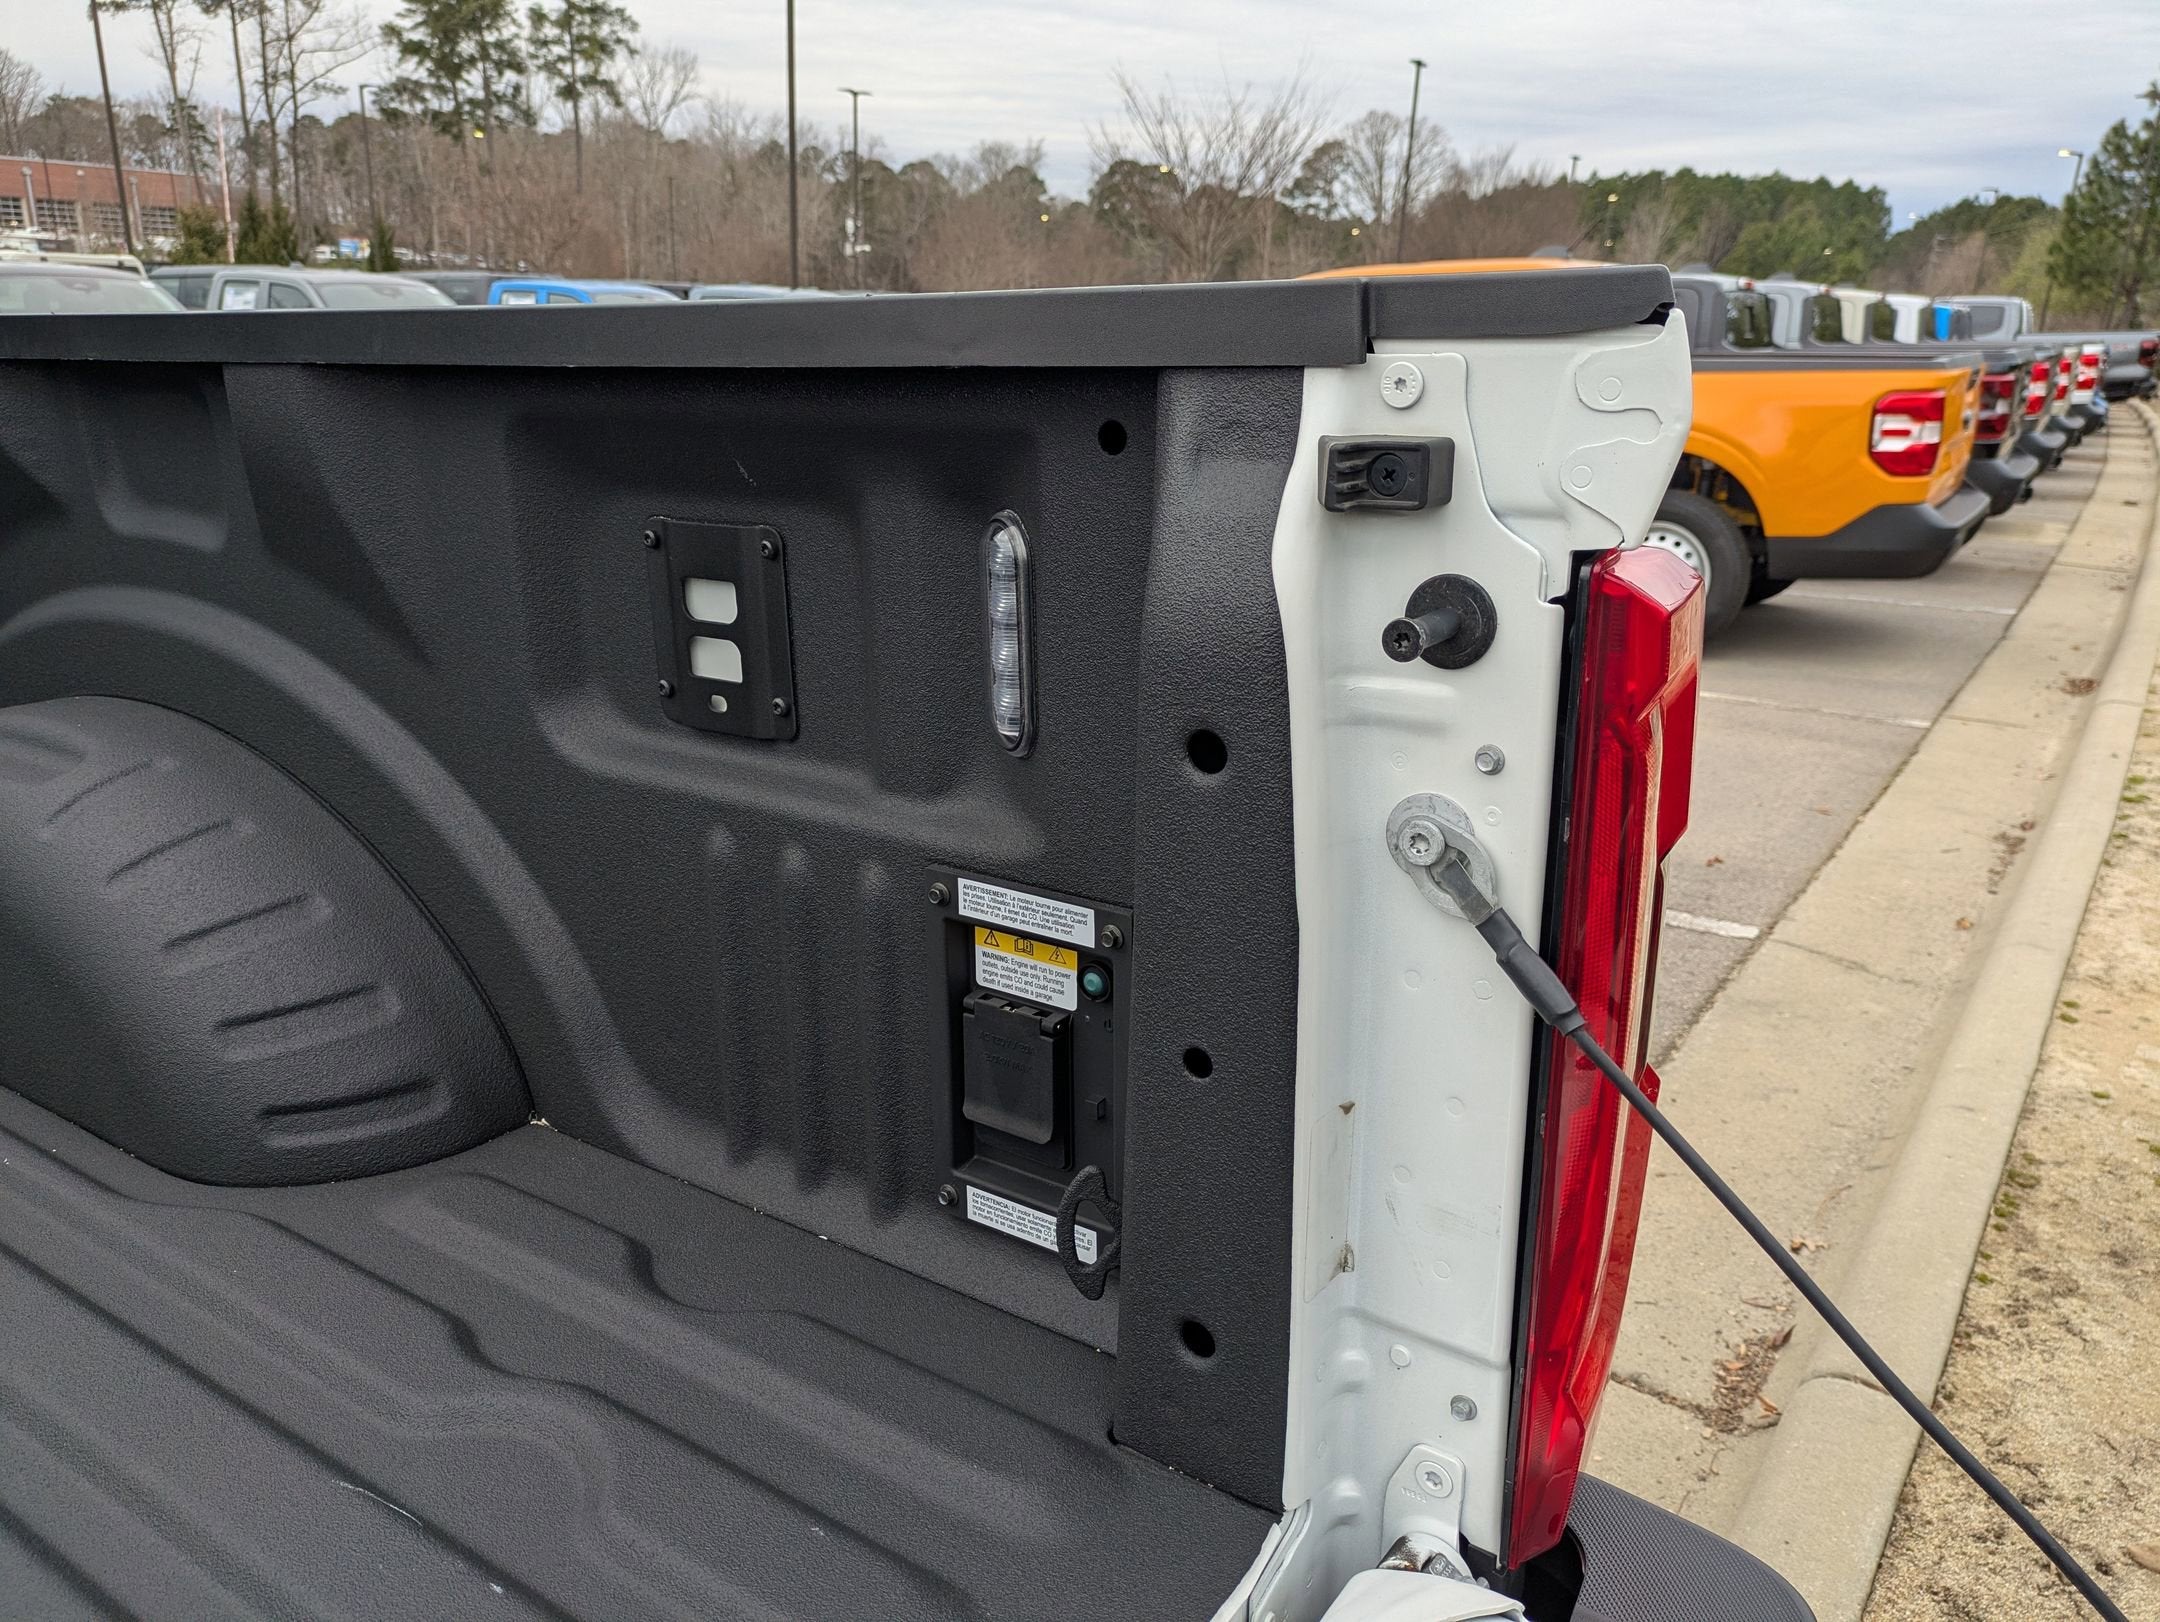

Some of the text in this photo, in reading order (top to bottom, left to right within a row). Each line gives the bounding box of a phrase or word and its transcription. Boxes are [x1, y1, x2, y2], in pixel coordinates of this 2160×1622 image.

[963, 883, 1008, 900] AVERTISSEMENT:
[1017, 897, 1034, 906] moteur
[1035, 900, 1051, 910] tourne
[1052, 905, 1063, 914] pour
[1065, 907, 1088, 919] alimenter
[969, 899, 985, 907] moteur
[986, 902, 1003, 913] tourne,
[1008, 908, 1020, 917] émet
[1029, 912, 1038, 921] CO.
[1040, 914, 1050, 924] Une
[1051, 919, 1075, 930] utilisation
[971, 893, 986, 902] prises.
[988, 896, 1011, 907] Utilisation
[1017, 903, 1040, 914] l'extérieur
[1041, 910, 1068, 921] seulement.
[1070, 915, 1087, 926] Quand
[968, 904, 989, 915] l'intérieur
[1001, 914, 1018, 924] garage
[1019, 918, 1030, 926] peut
[1060, 928, 1073, 936] mort.
[982, 950, 1010, 964] WARNING:
[1011, 958, 1028, 969] Engine
[1039, 966, 1047, 974] run
[1048, 968, 1054, 976] to
[1055, 970, 1071, 980] power
[982, 960, 999, 971] outlets,
[1001, 965, 1018, 975] outside
[1030, 972, 1041, 982] only.
[1043, 975, 1064, 988] Running
[982, 968, 1064, 996] engine emits CO and could cause
[983, 976, 996, 985] death
[1001, 981, 1013, 990] used
[1015, 985, 1029, 995] inside
[1035, 991, 1054, 1002] garage.
[972, 1191, 1010, 1210] ADVERTENCIA:
[1018, 1209, 1031, 1218] motor
[972, 1204, 985, 1213] motor
[993, 1211, 1028, 1229] funcionamiento
[1030, 1225, 1042, 1235] emite
[1044, 1229, 1052, 1238] CO
[978, 1212, 994, 1223] muerte
[1006, 1223, 1015, 1231] usa
[1017, 1226, 1034, 1238] adentro
[1015, 1213, 1026, 1221] usar
[1028, 1217, 1052, 1231] solamente
[1087, 1238, 1092, 1246] El
